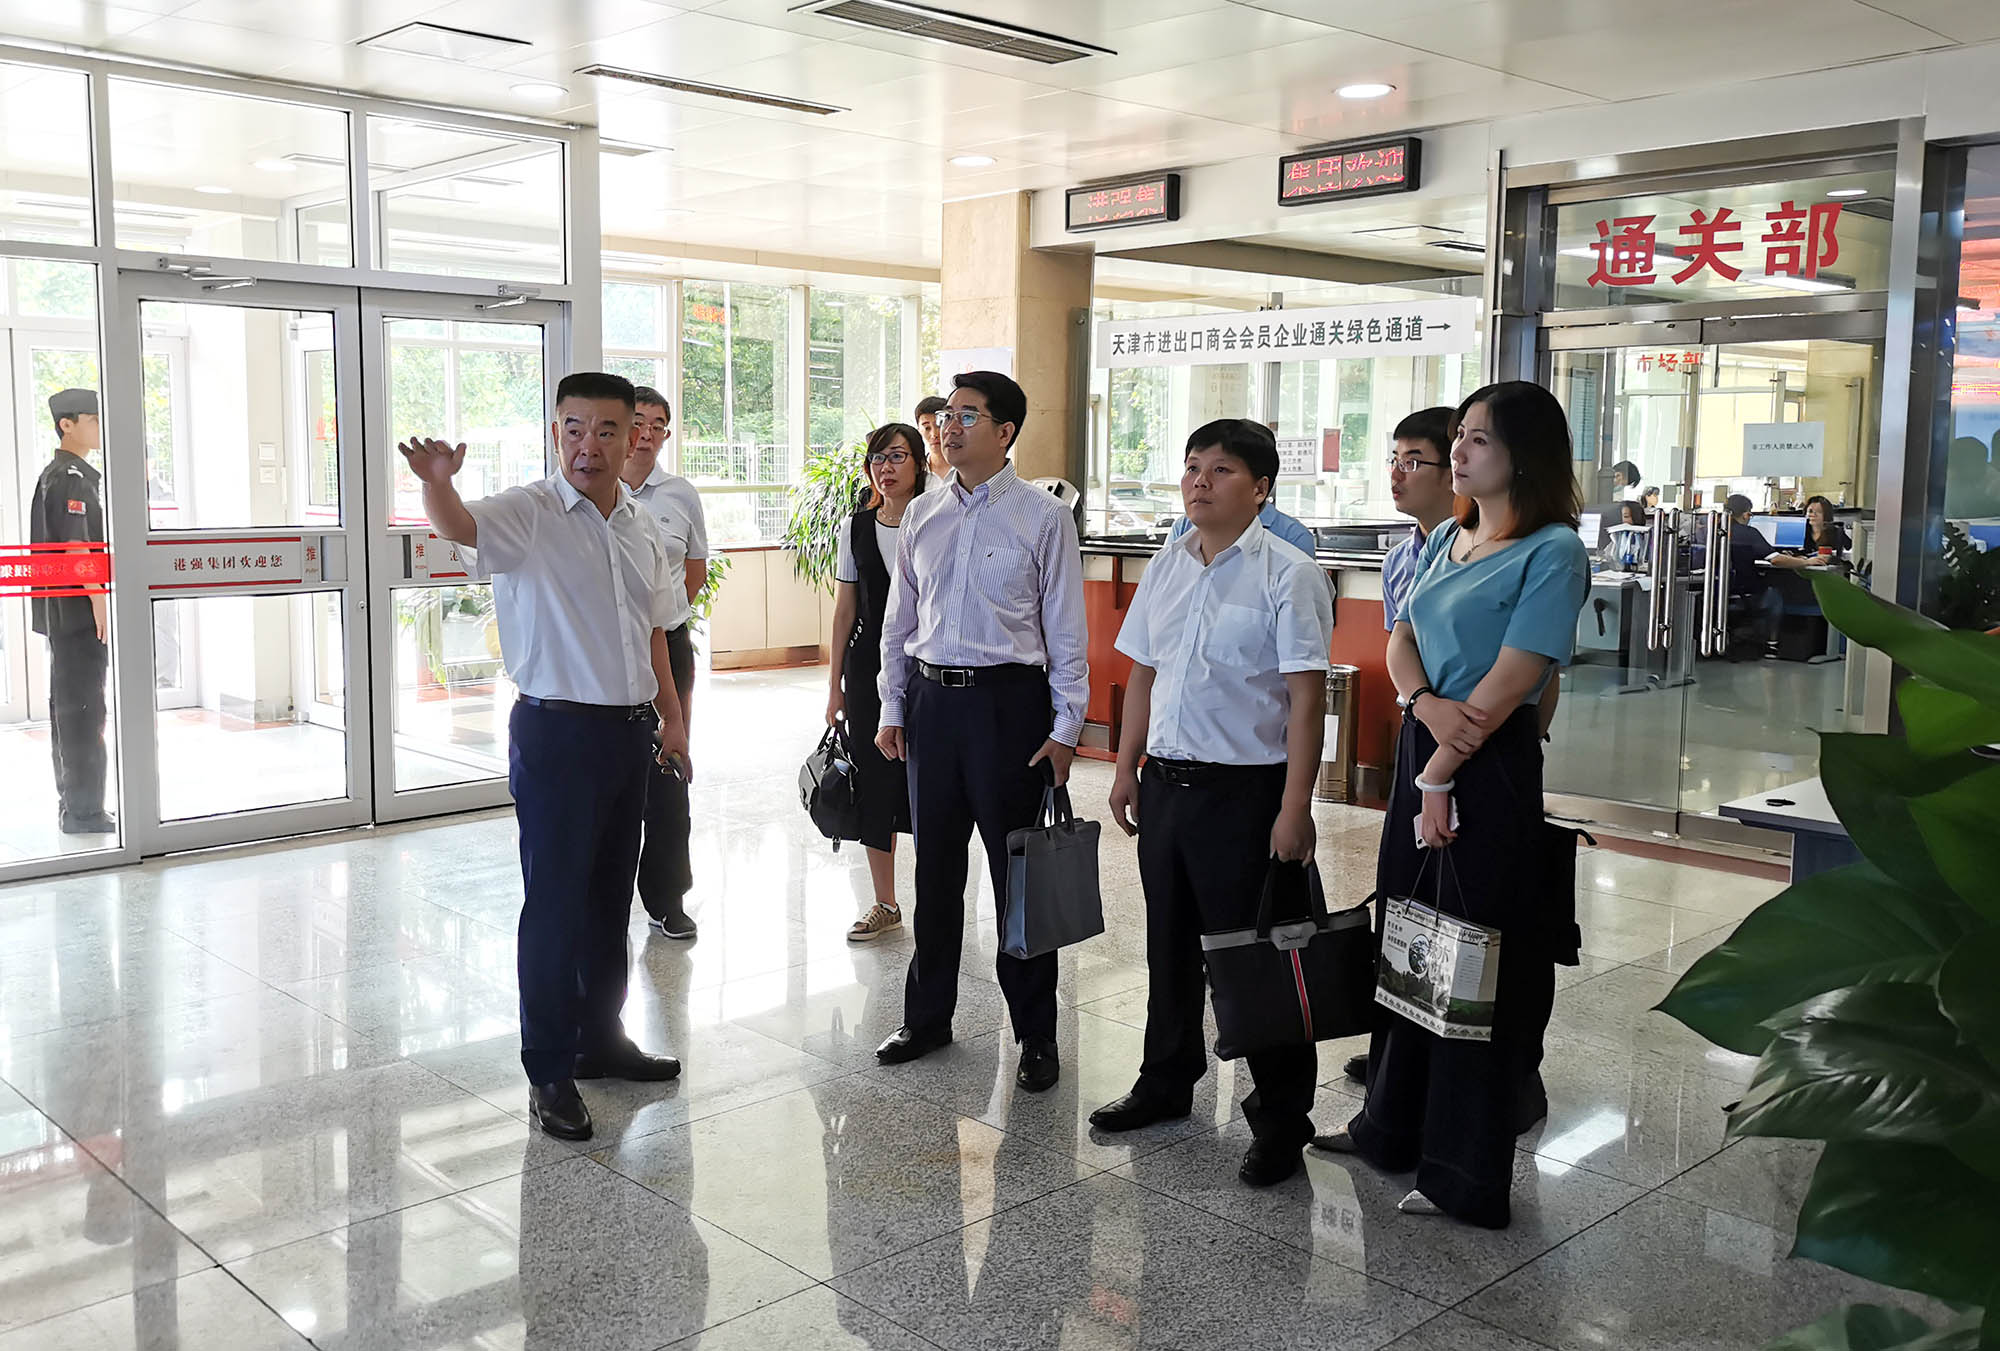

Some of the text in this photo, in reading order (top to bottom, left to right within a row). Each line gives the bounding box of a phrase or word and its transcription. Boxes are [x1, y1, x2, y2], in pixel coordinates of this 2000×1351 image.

[1587, 200, 1843, 288] 通关部
[1112, 315, 1424, 356] 天津市进出口商会会员企业通关绿色通道
[174, 554, 283, 571] 港强集团欢迎您
